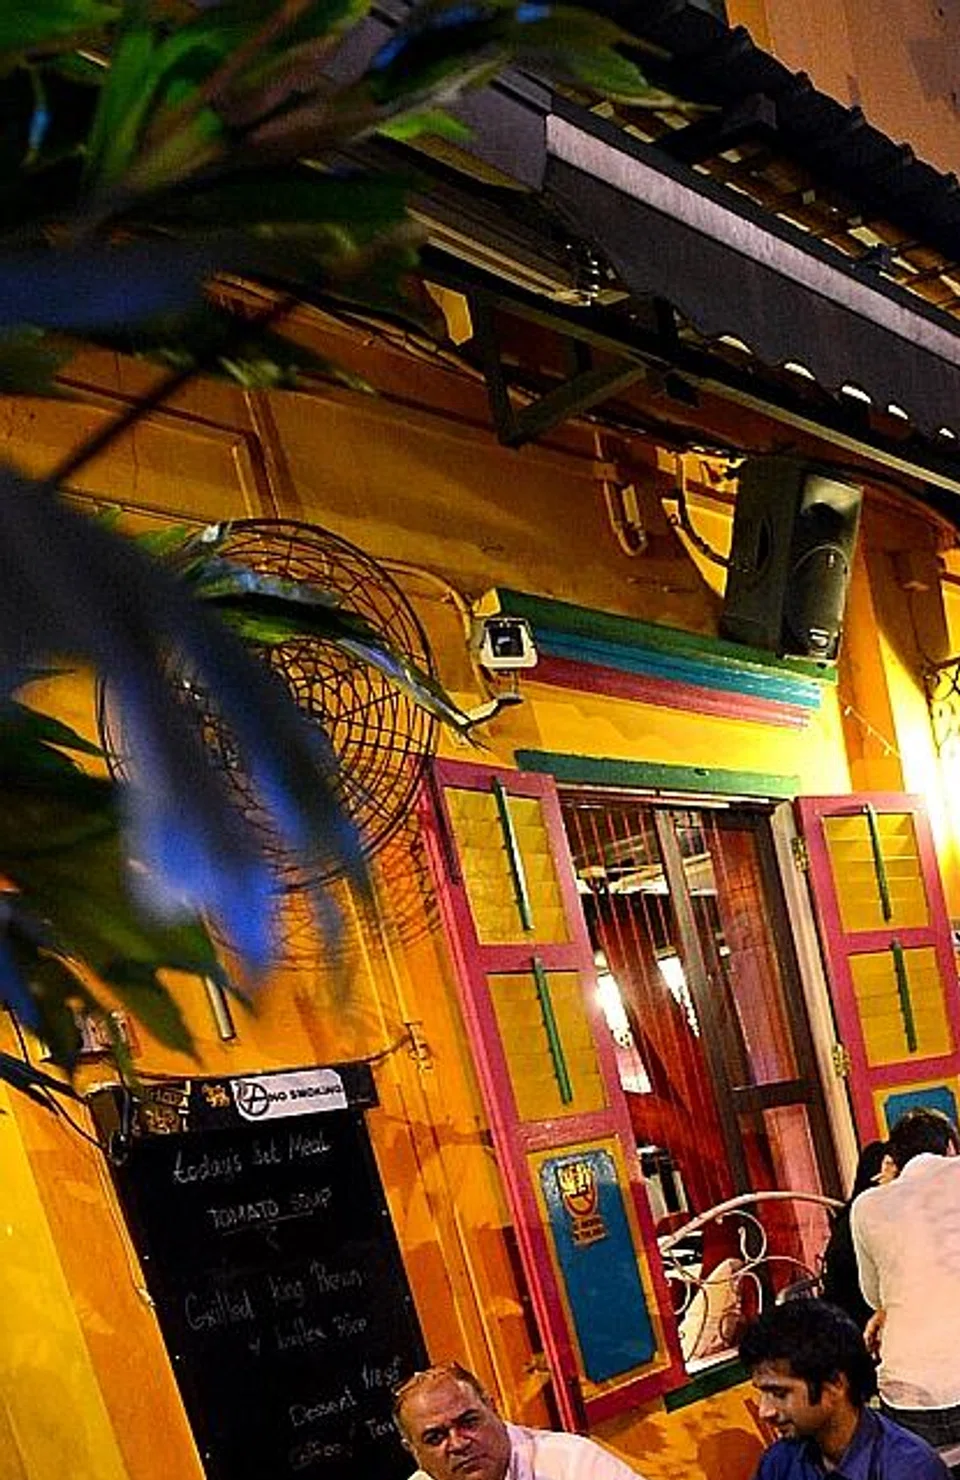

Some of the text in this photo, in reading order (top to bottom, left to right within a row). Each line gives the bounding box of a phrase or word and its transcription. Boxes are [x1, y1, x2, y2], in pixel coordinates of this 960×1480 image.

[269, 1084, 342, 1104] NO SMOKING
[206, 1199, 280, 1230] TOMATO
